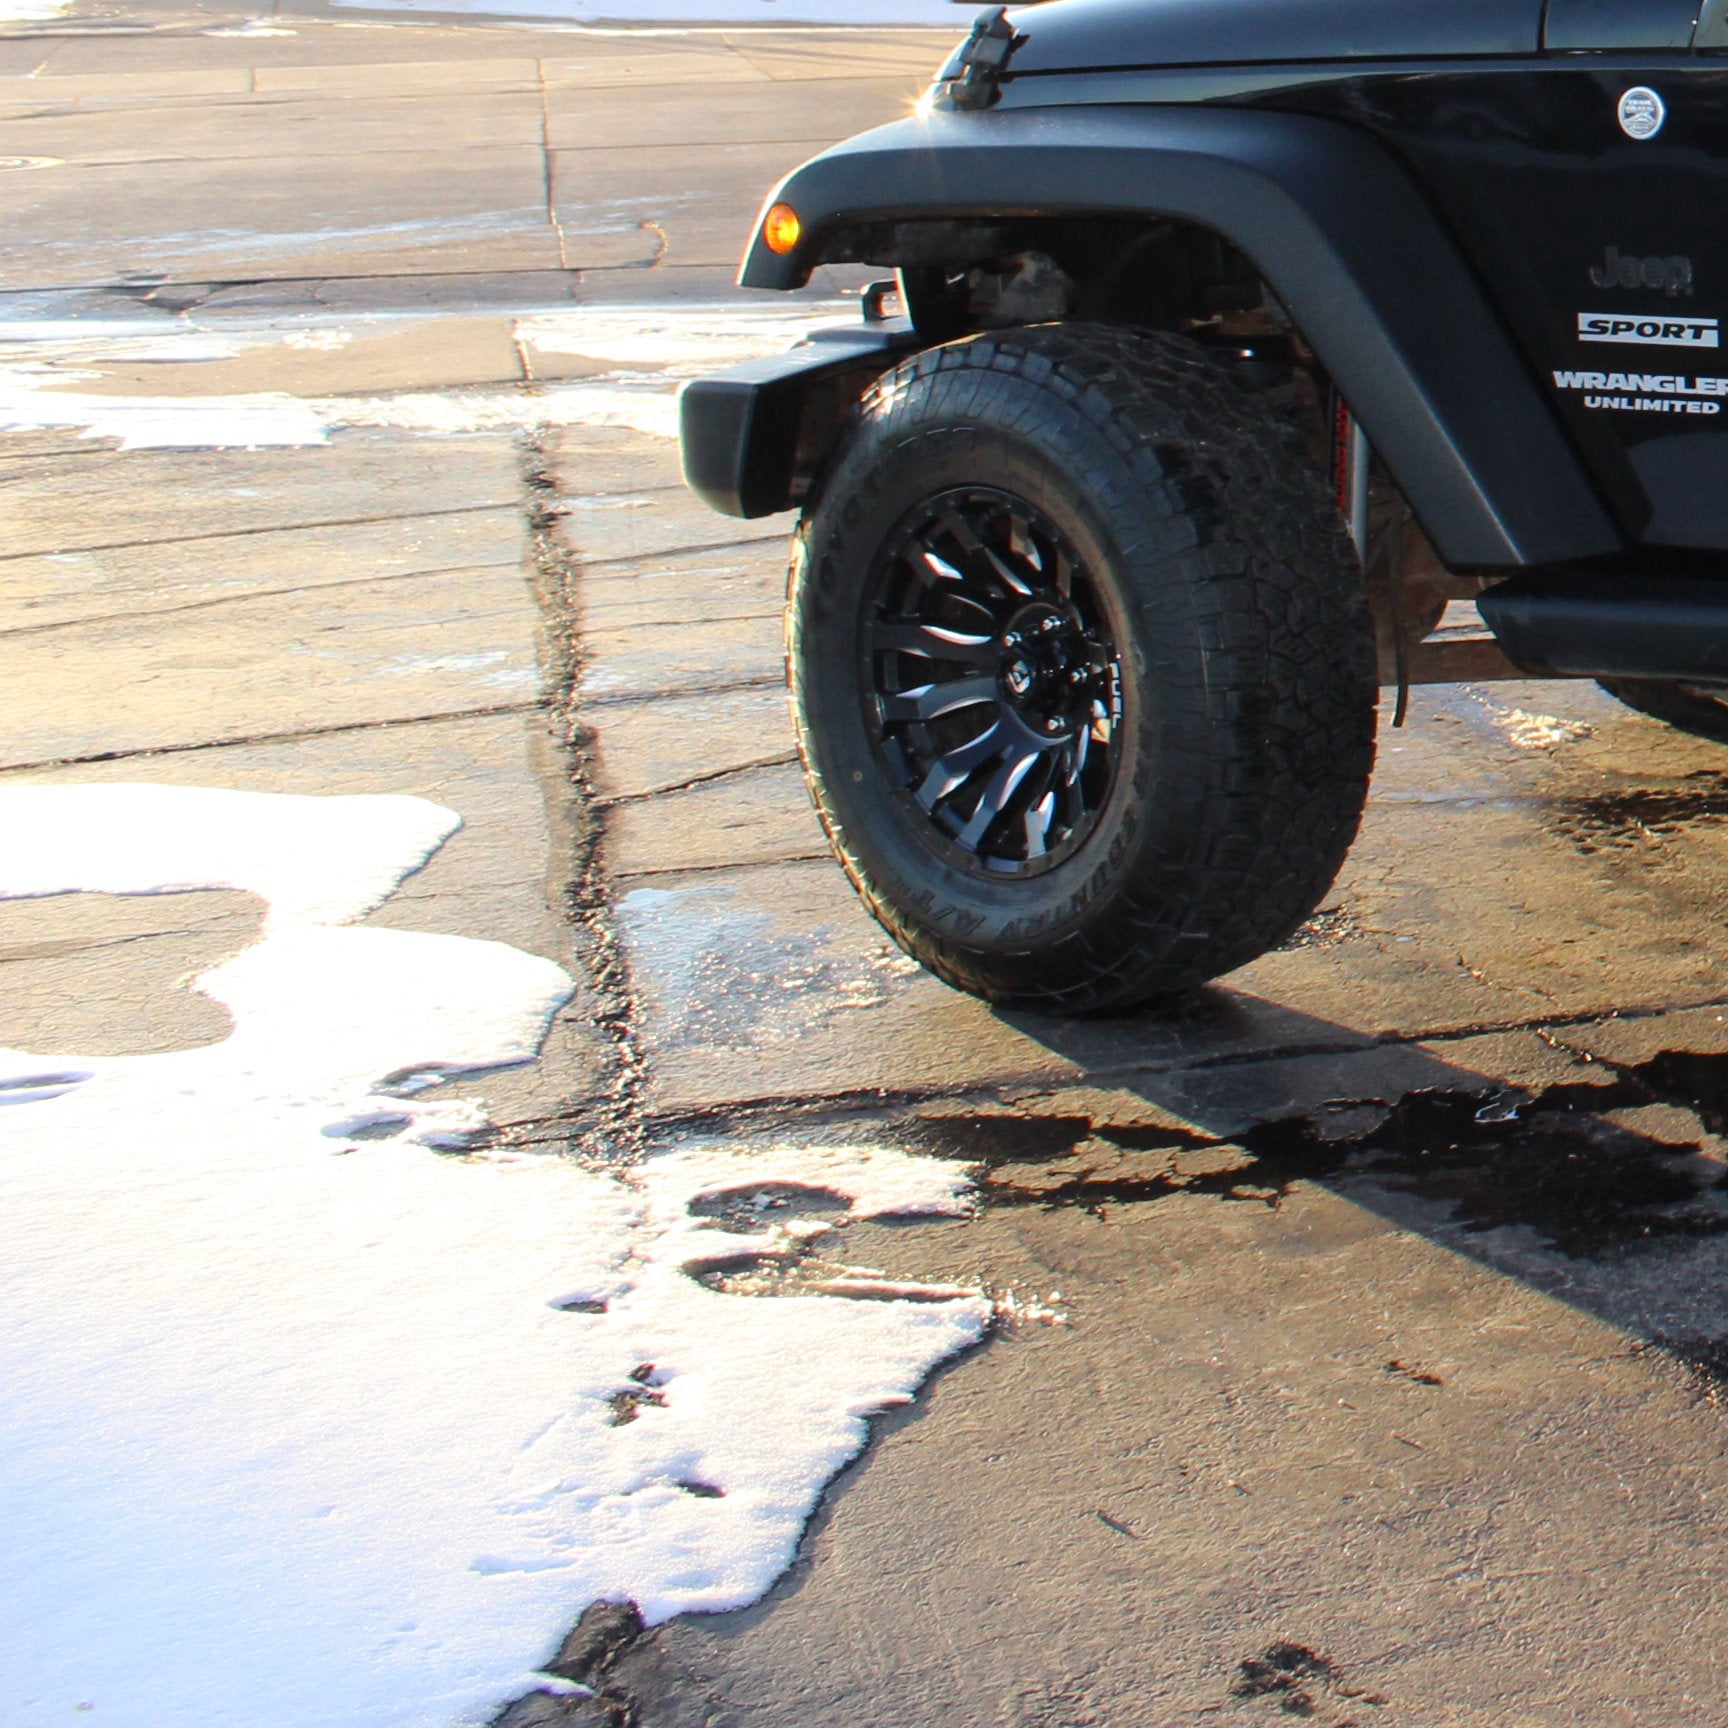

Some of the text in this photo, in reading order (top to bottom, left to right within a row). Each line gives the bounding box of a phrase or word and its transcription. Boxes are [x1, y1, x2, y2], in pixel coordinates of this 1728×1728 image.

[1590, 245, 1694, 297] Jeep
[1586, 319, 1713, 340] SPORT
[1584, 396, 1720, 414] UNLIMITED
